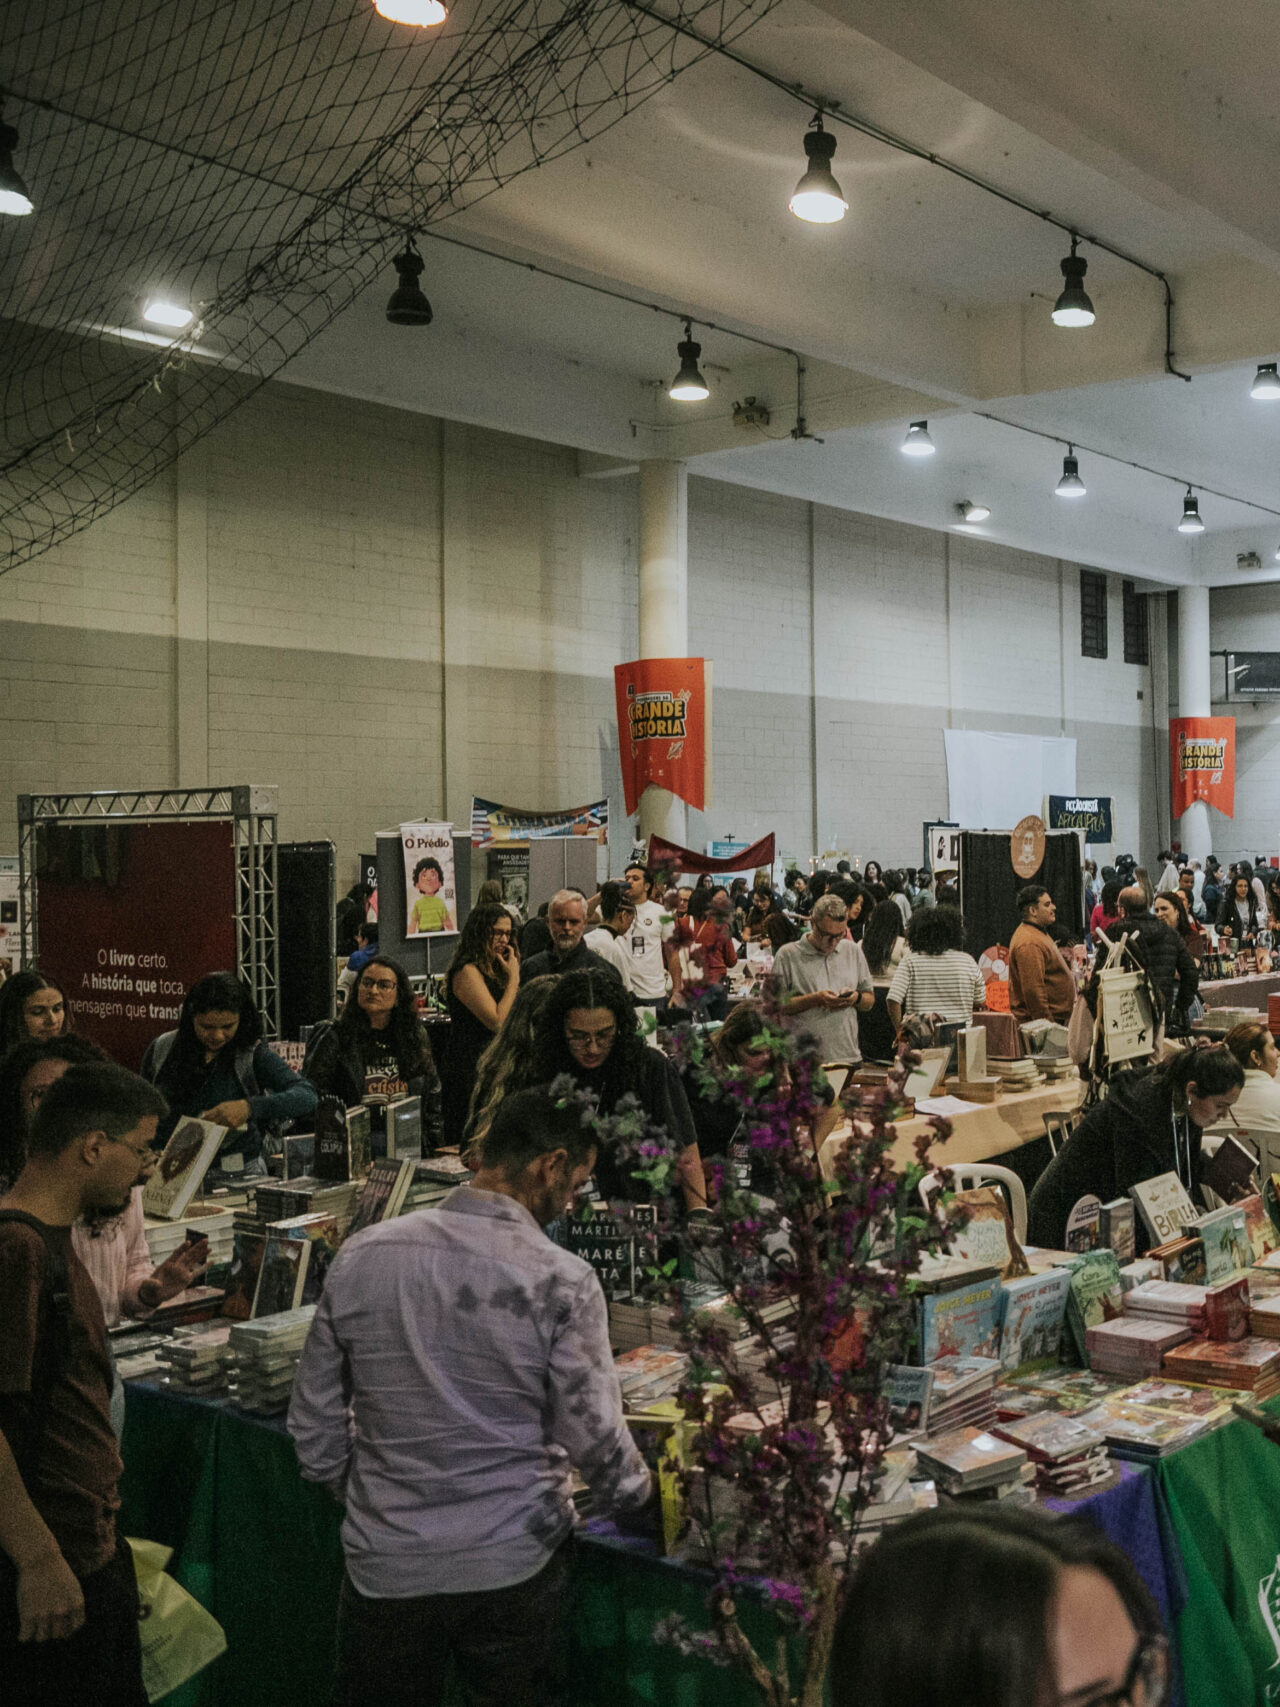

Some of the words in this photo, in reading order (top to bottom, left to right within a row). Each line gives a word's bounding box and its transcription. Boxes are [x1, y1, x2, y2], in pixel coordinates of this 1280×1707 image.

[630, 700, 683, 720] GRANDE
[405, 838, 414, 848] O
[418, 836, 449, 848] Prédio
[97, 949, 108, 966] O
[109, 949, 136, 966] livro
[138, 952, 168, 969] certo.
[82, 973, 90, 988] A
[91, 972, 133, 992] história
[135, 980, 157, 996] que
[159, 980, 187, 996] toca.
[126, 1004, 146, 1018] que
[578, 1246, 624, 1260] MARÉ
[1038, 1282, 1060, 1296] MEYER
[963, 1289, 992, 1304] MEYER
